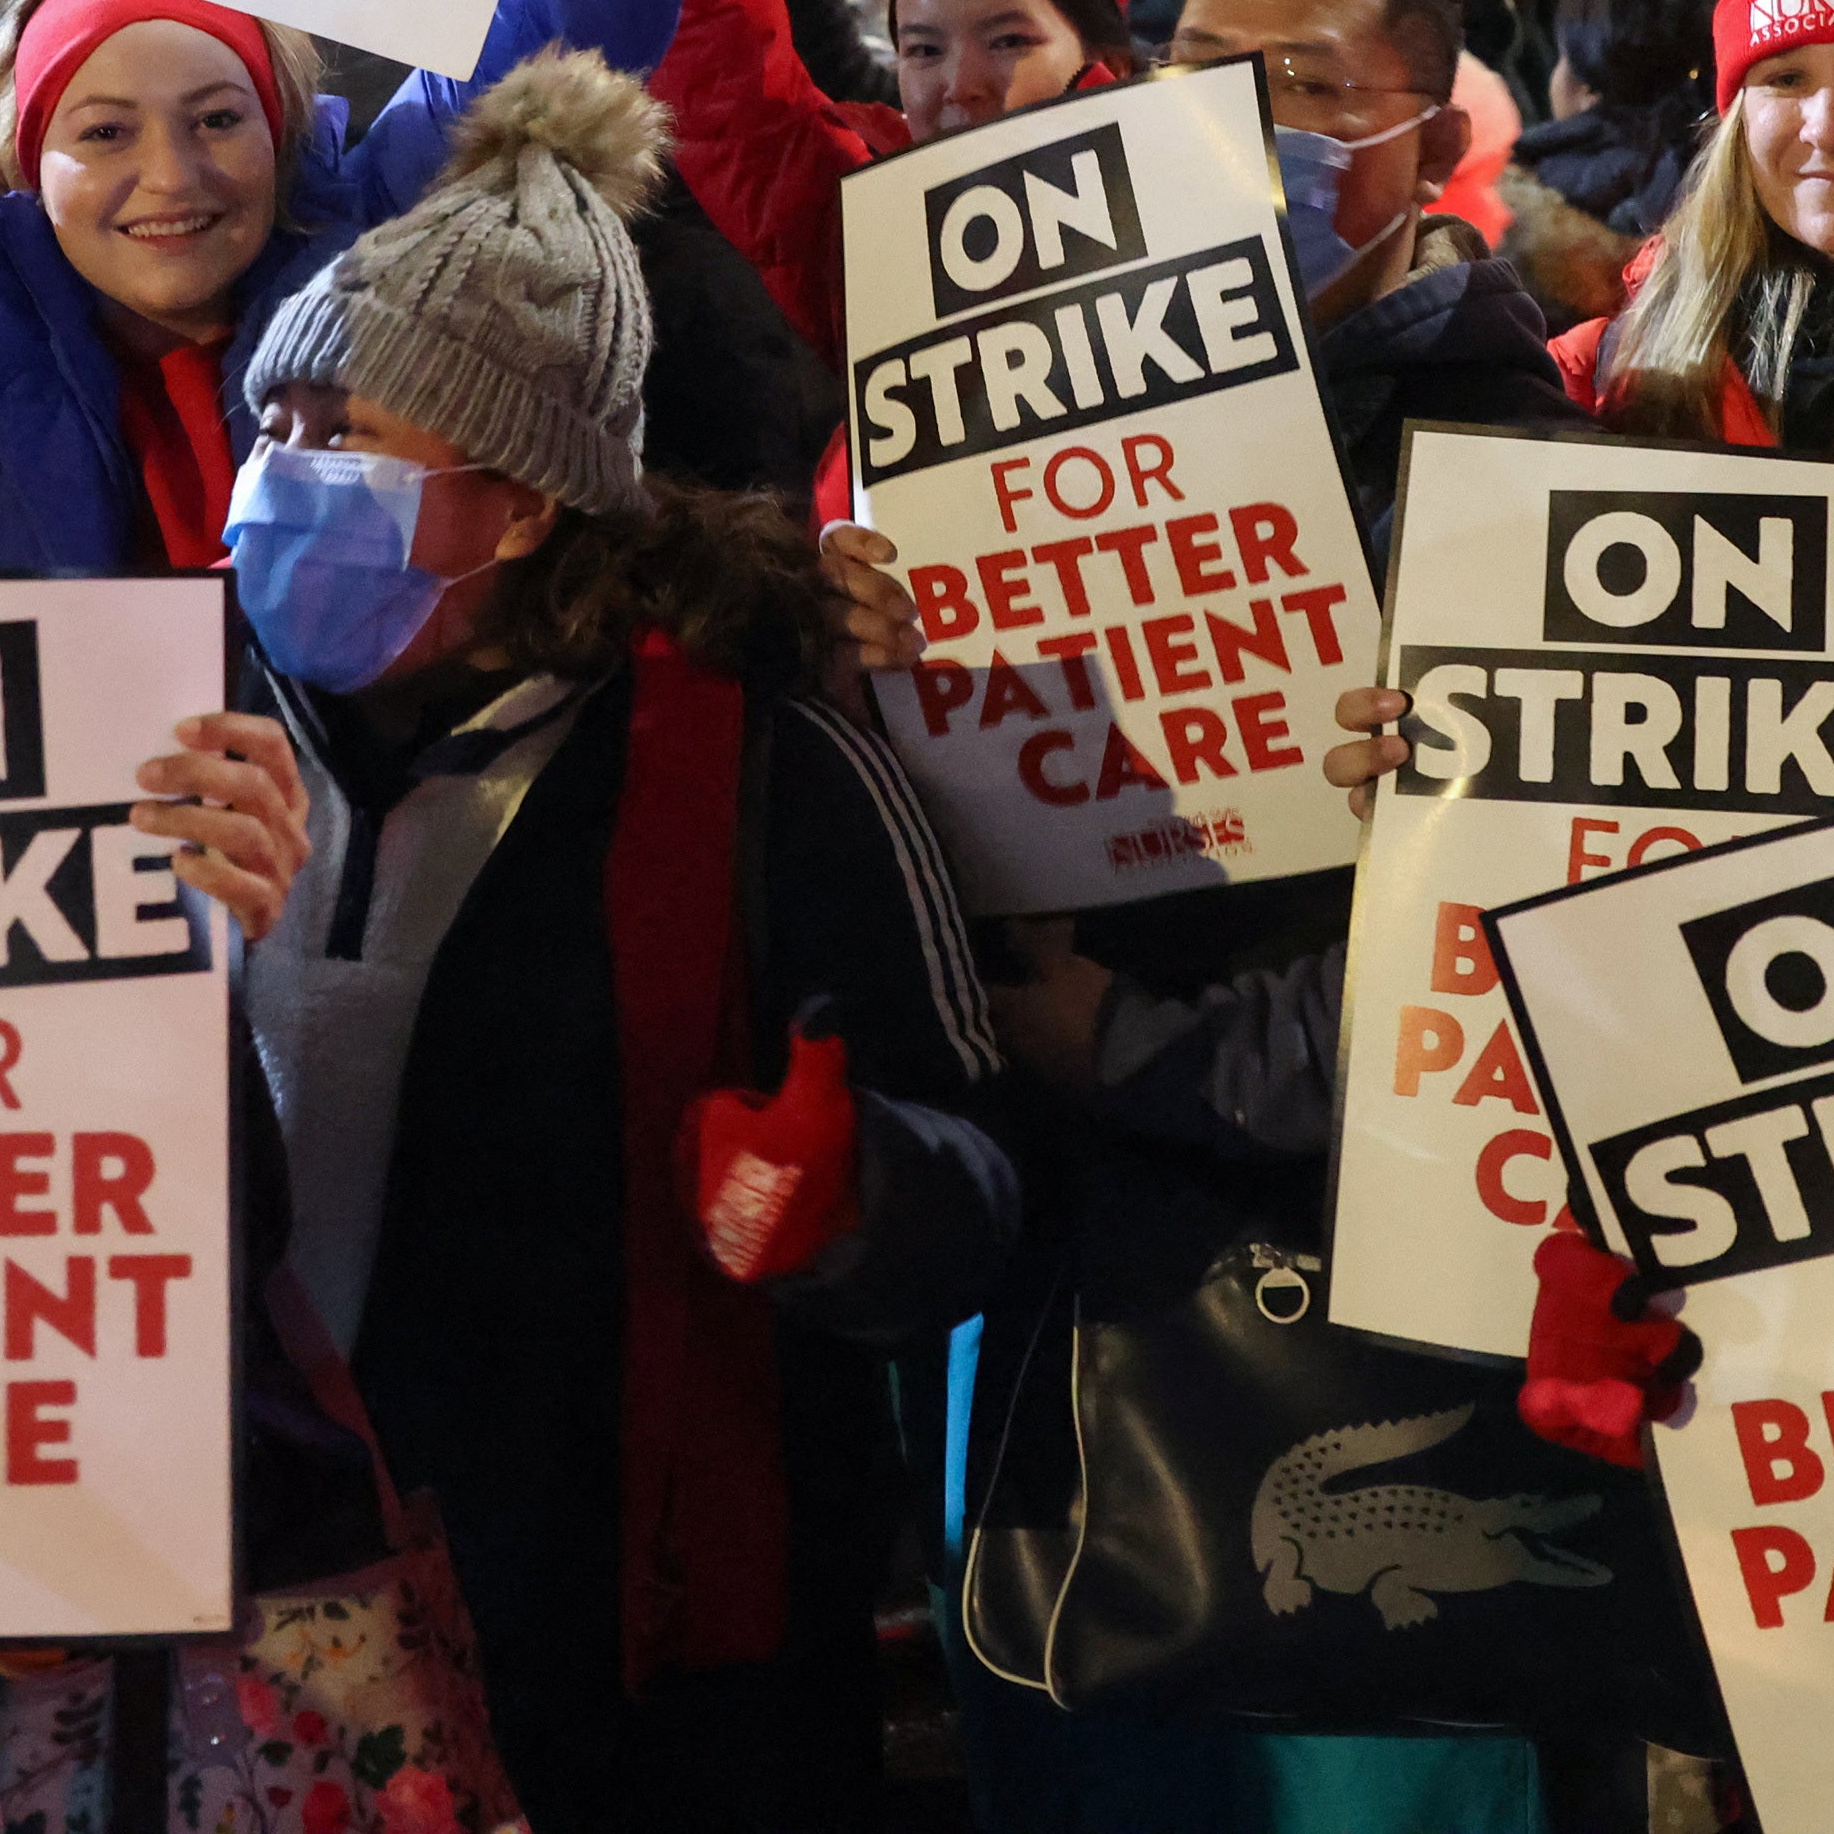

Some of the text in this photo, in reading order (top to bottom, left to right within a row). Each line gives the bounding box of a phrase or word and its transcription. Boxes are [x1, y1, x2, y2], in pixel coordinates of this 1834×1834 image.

[939, 148, 1117, 293] ON
[863, 255, 1278, 468] STRIKE
[990, 432, 1186, 534] FOR
[907, 501, 1311, 642] BETTER
[1563, 510, 1794, 634] ON
[912, 582, 1347, 738] PATIENT
[1017, 690, 1305, 807] CARE
